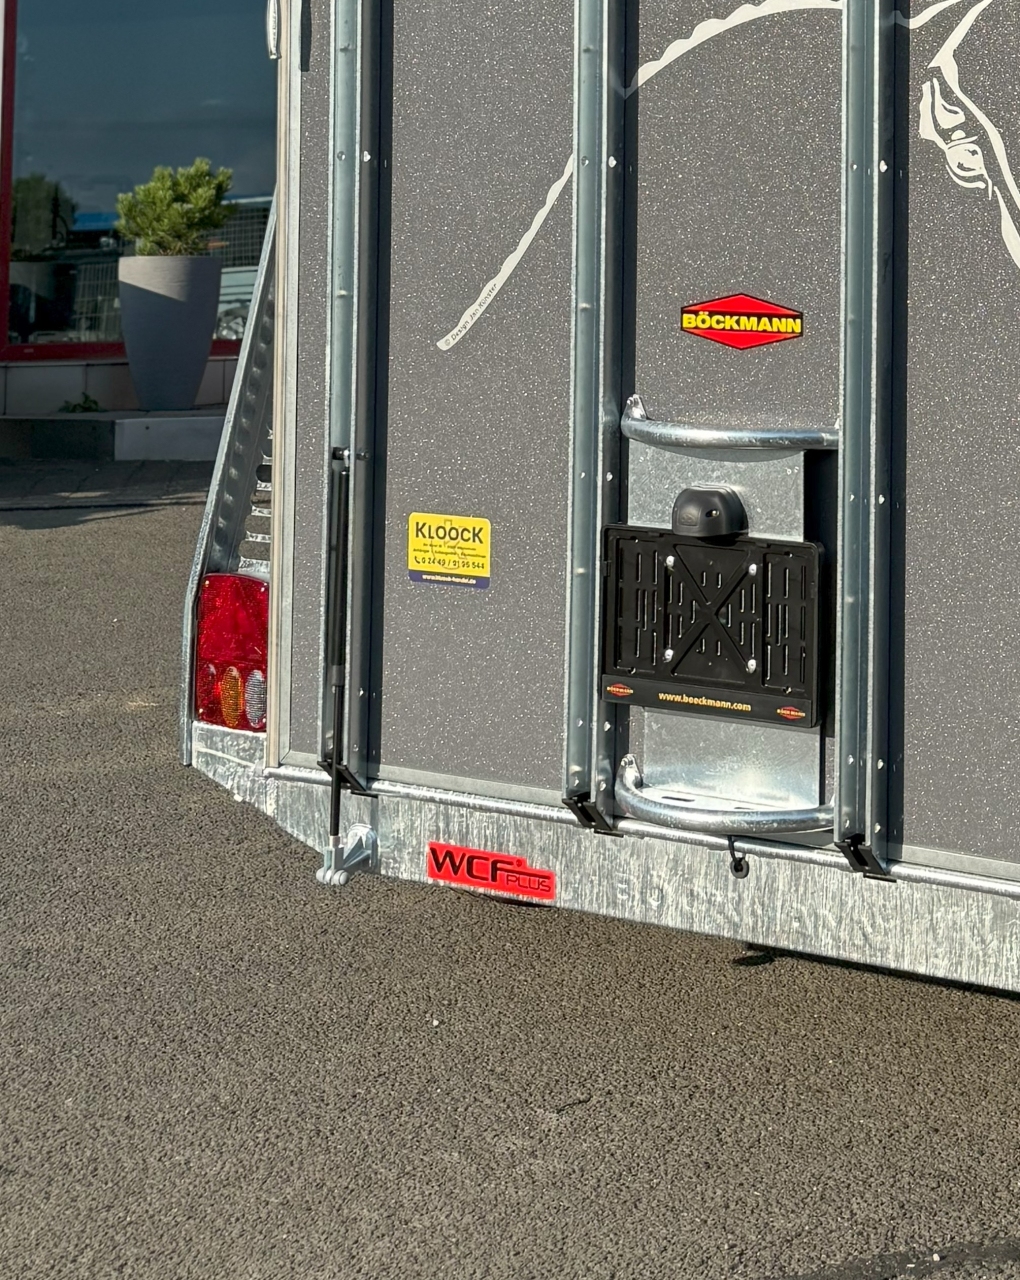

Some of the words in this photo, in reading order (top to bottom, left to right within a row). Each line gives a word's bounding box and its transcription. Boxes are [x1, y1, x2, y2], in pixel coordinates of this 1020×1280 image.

[451, 320, 470, 341] Design
[469, 308, 480, 321] Jan
[682, 311, 802, 333] BÖCKMANN
[415, 521, 484, 544] KLOOCK
[658, 692, 752, 712] www.boeckmann.com
[505, 874, 552, 893] PLUS
